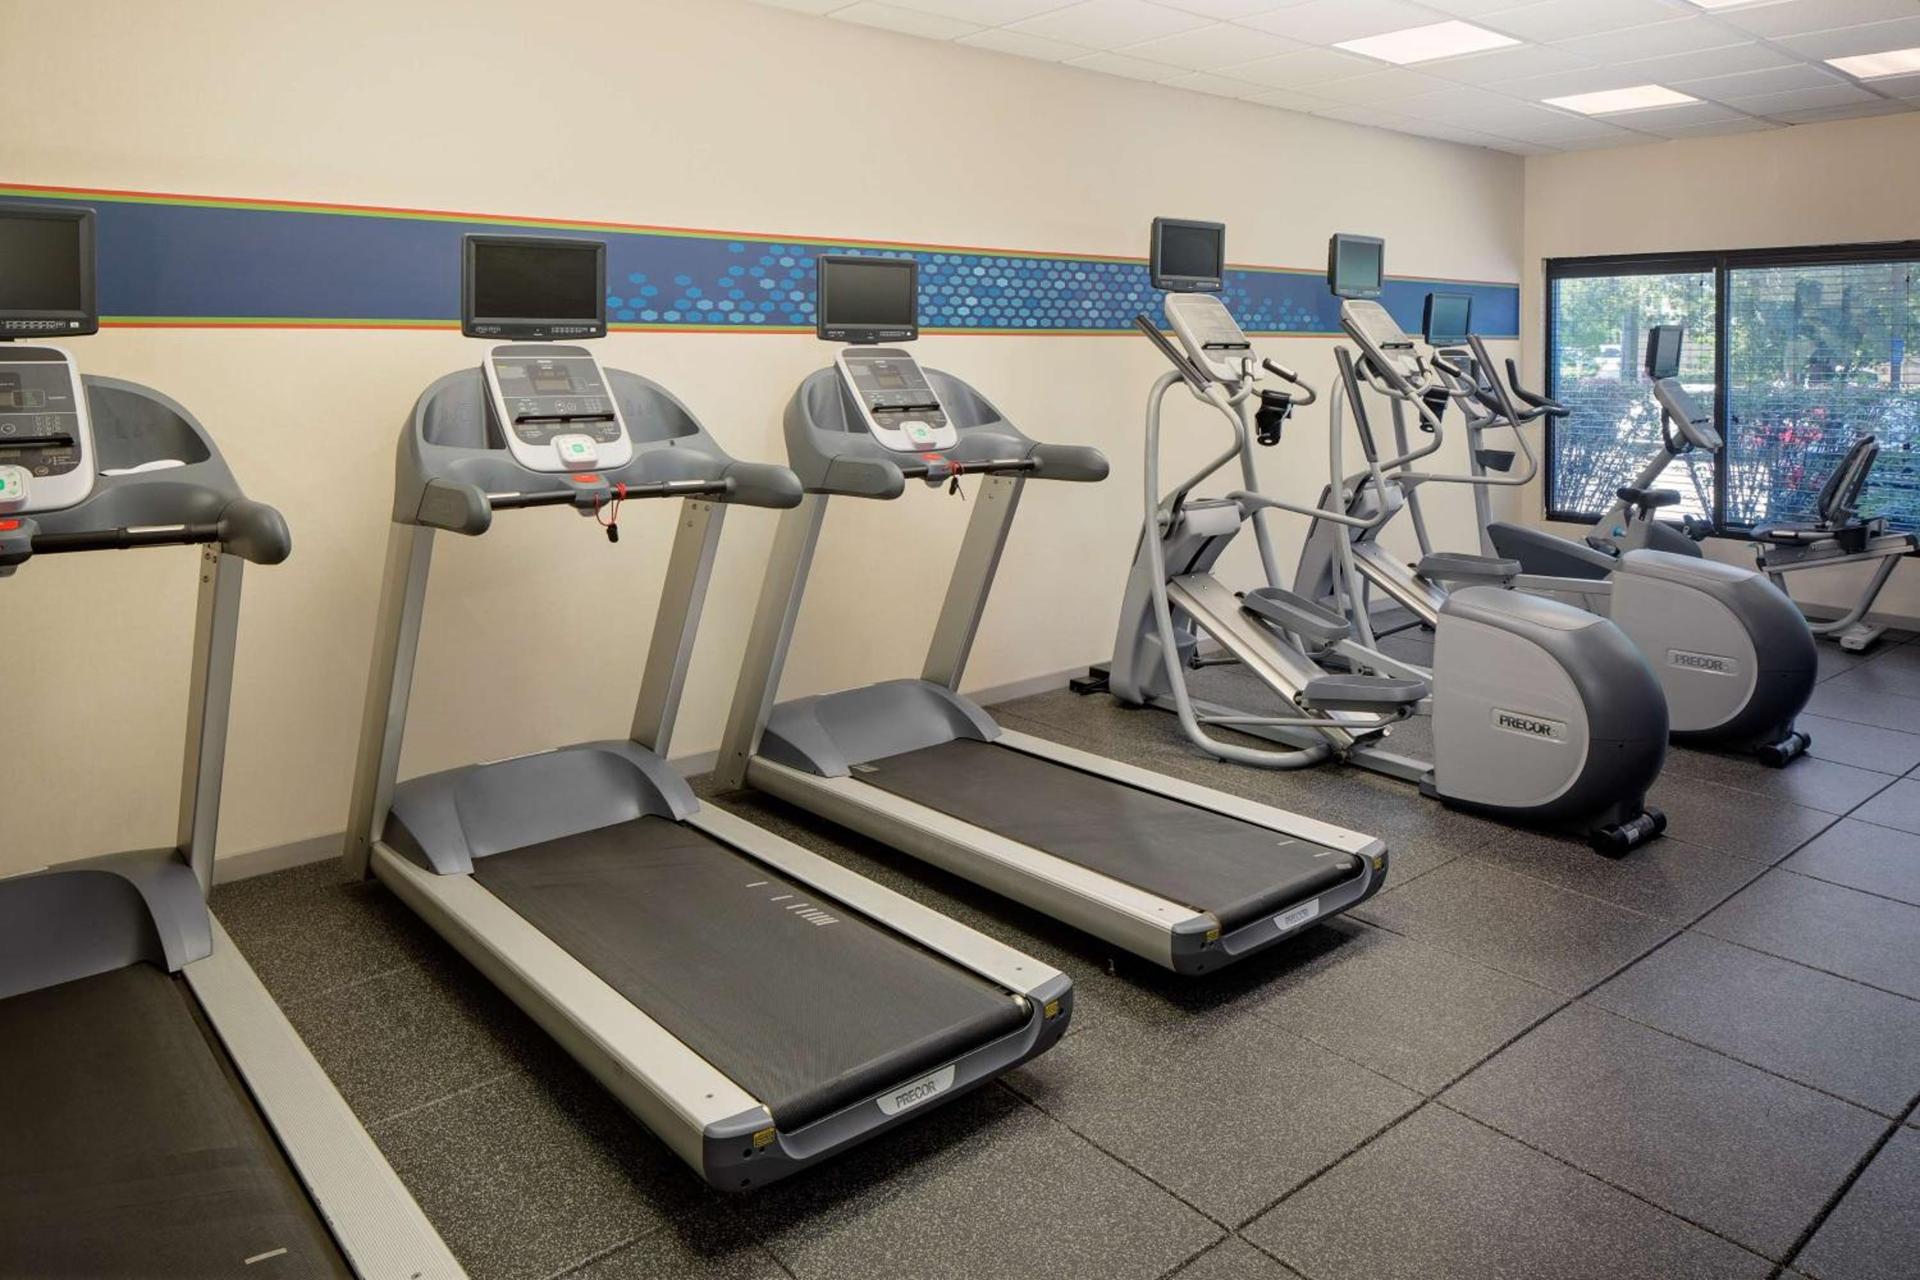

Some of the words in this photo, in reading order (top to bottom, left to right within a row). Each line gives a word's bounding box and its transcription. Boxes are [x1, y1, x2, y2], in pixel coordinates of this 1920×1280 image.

[1675, 654, 1723, 670] PRECOR
[1499, 715, 1551, 736] PRECOR
[895, 1081, 937, 1108] PRECOR
